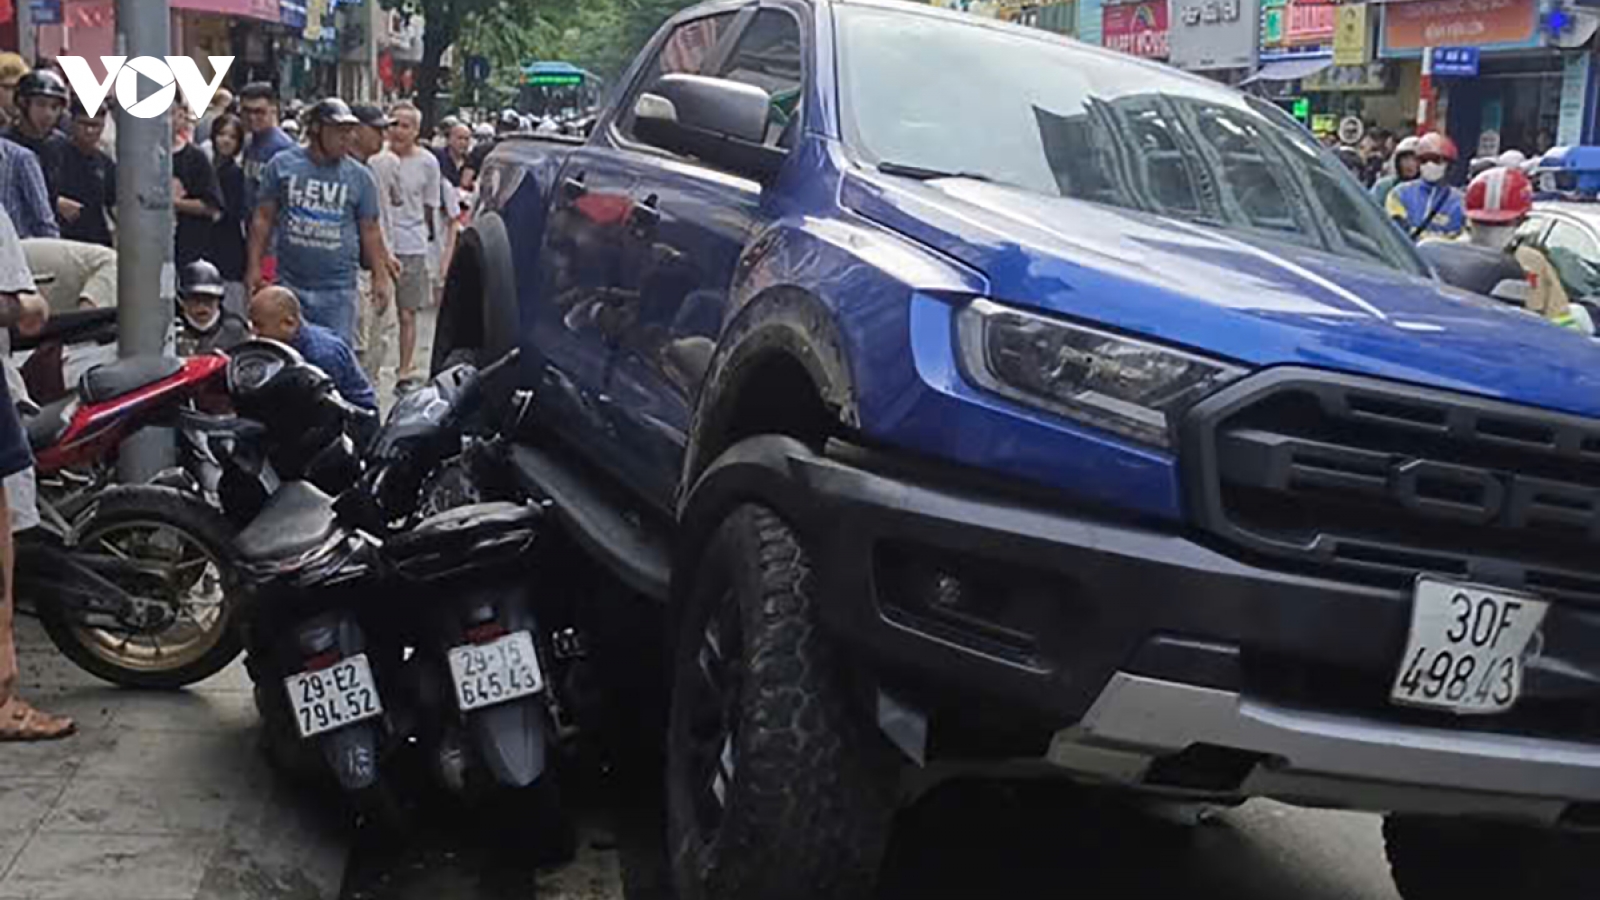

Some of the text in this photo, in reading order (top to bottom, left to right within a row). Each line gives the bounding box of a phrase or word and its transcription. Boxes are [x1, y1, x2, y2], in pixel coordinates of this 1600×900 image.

[1265, 440, 1600, 545] FOR
[1446, 592, 1522, 649] 30F
[298, 663, 361, 703] 29-E2
[1400, 647, 1514, 705] 498.43
[299, 688, 376, 733] 794.52
